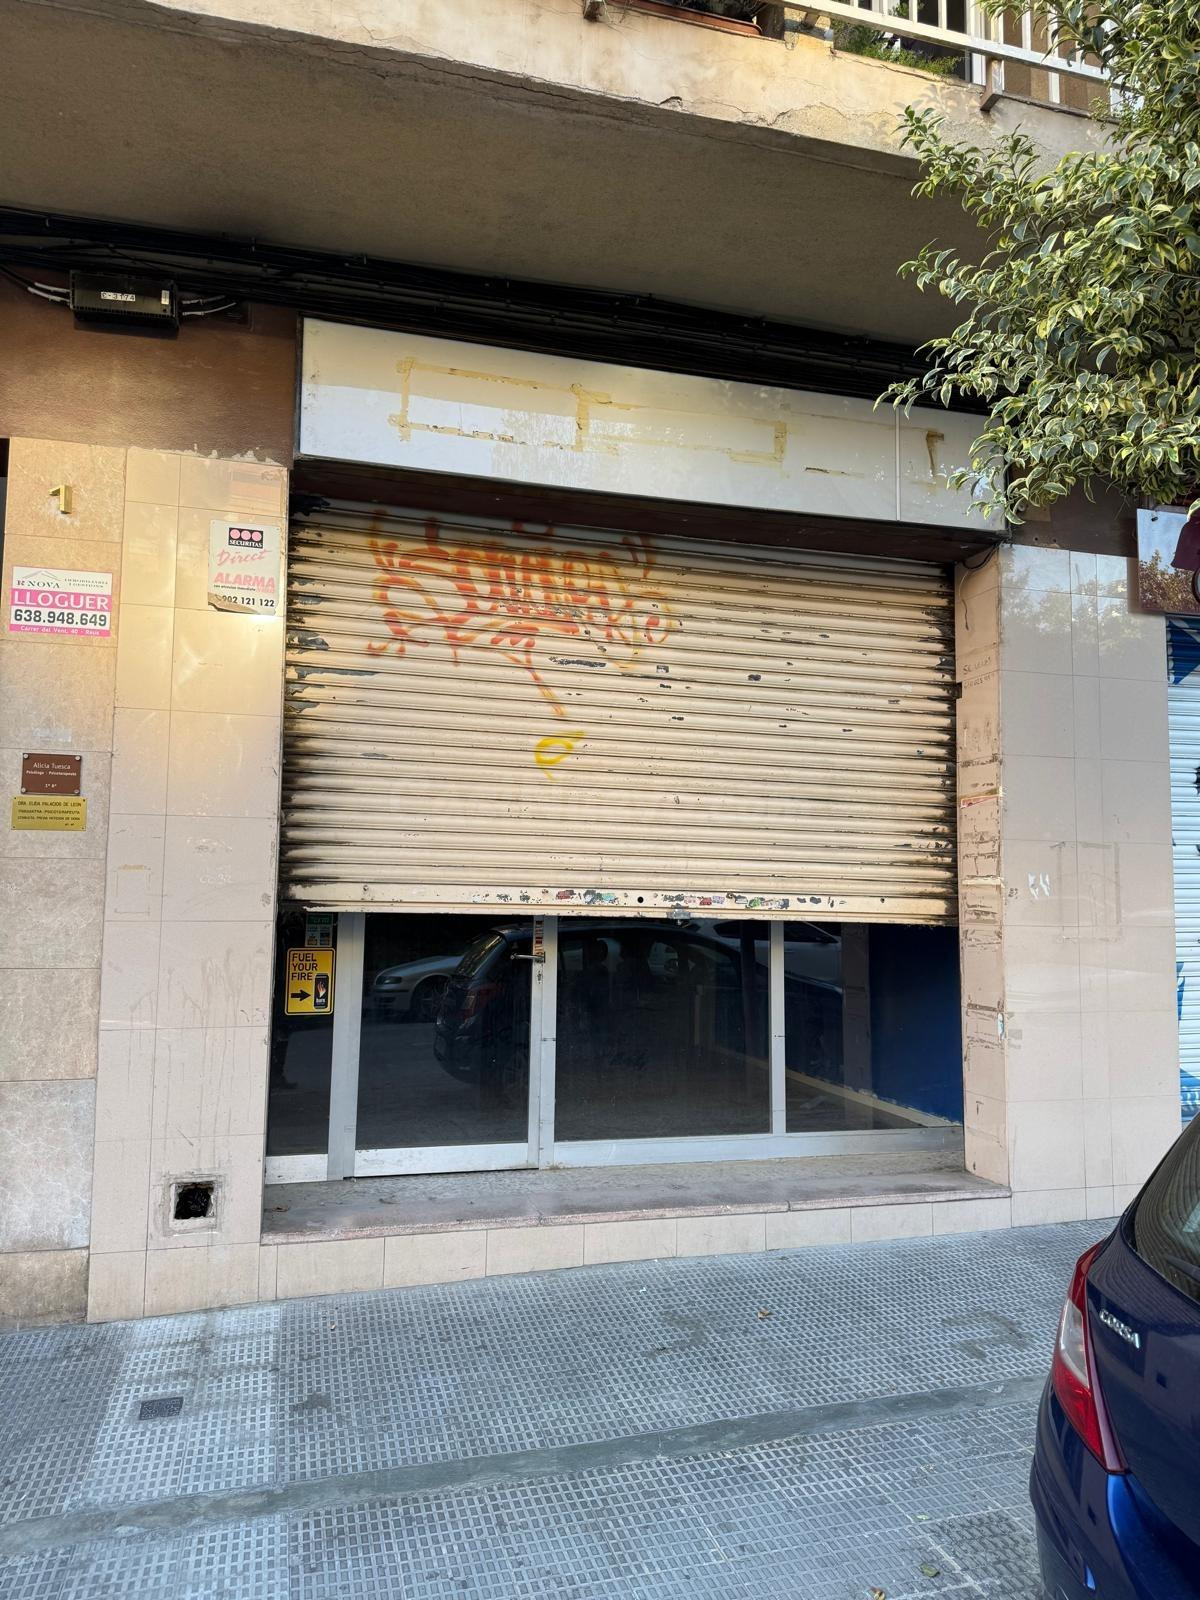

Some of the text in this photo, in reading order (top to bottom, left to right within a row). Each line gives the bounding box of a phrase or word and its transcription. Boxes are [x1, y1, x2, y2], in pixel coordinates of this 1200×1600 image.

[48, 485, 72, 514] 1
[229, 539, 263, 548] SECURITAS
[217, 549, 273, 566] Direct
[213, 572, 275, 588] ALARMA
[13, 591, 109, 610] LLOGUER
[241, 597, 255, 606] 121
[259, 599, 275, 607] 122
[14, 609, 107, 627] 638.948.649
[292, 953, 317, 962] FUEL
[292, 962, 318, 972] YOUR
[291, 972, 313, 981] FIRE
